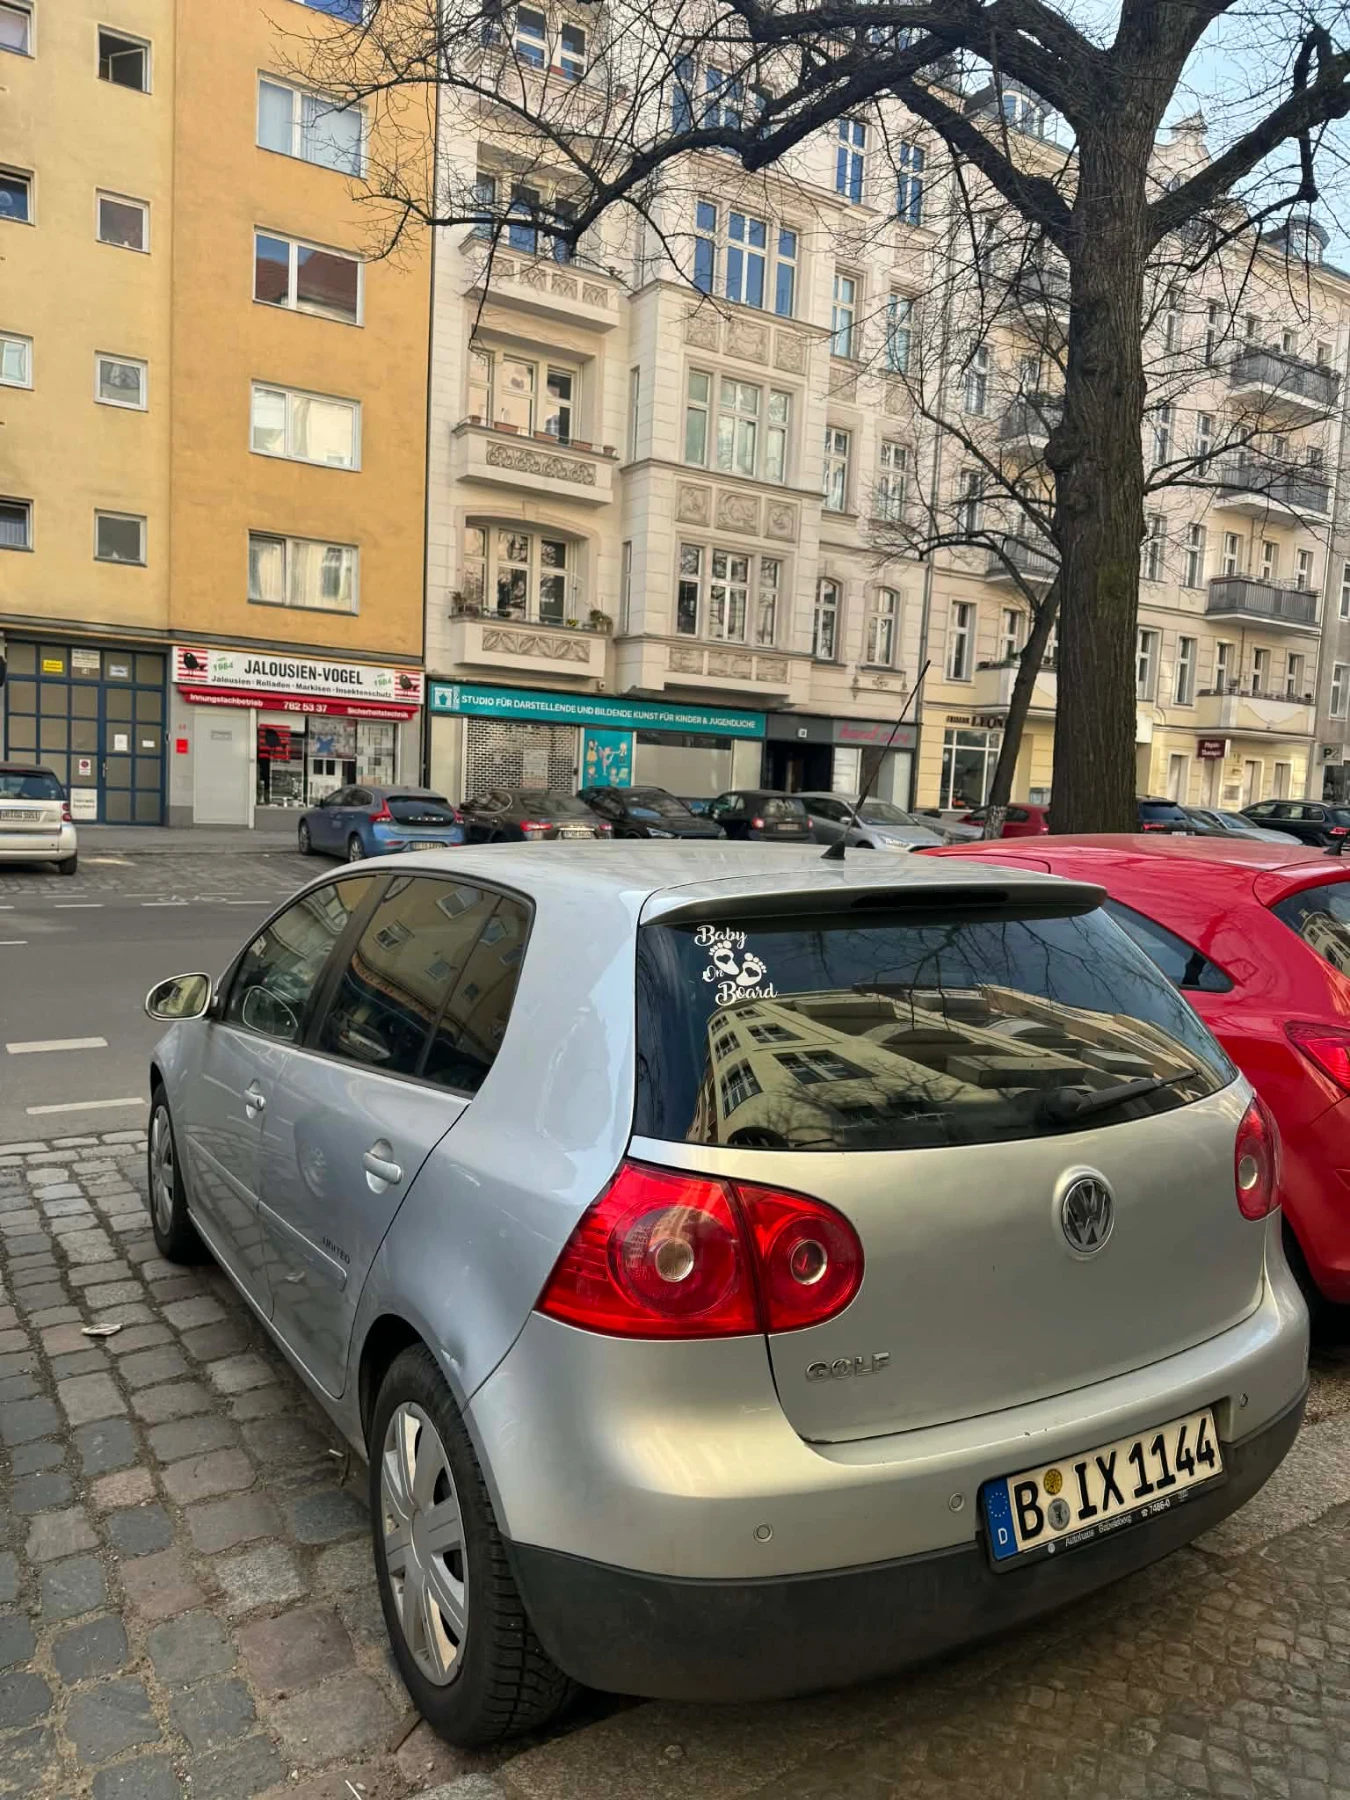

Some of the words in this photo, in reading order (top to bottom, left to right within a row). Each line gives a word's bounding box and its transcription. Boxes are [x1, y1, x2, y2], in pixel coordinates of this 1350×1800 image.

[244, 660, 363, 685] JALOUSIEN-VOGEL
[211, 675, 251, 685] Jalousien
[296, 683, 331, 693] Markisen
[336, 687, 393, 698] Insektenschutz
[190, 693, 263, 707] Innungsfachbetrieb
[283, 701, 301, 711] 782
[303, 702, 315, 712] 53
[316, 704, 327, 713] 37
[347, 707, 409, 718] Sicherheitstechnik
[461, 695, 494, 706] STUDIO
[496, 696, 513, 707] FÜR
[514, 699, 576, 713] DARSTELLENDE
[577, 704, 594, 715] UND
[594, 707, 632, 718] BILDENDE
[633, 711, 658, 721] KUNST
[659, 711, 674, 722] FÜR
[675, 713, 702, 724] KINDER
[703, 716, 708, 725] &
[709, 717, 755, 729] JUGENDLICHE
[694, 925, 747, 949] Baby
[702, 965, 724, 982] On
[715, 980, 778, 1006] Board
[806, 1351, 890, 1382] GOLF
[998, 1527, 1008, 1545] D
[1013, 1480, 1044, 1541] B
